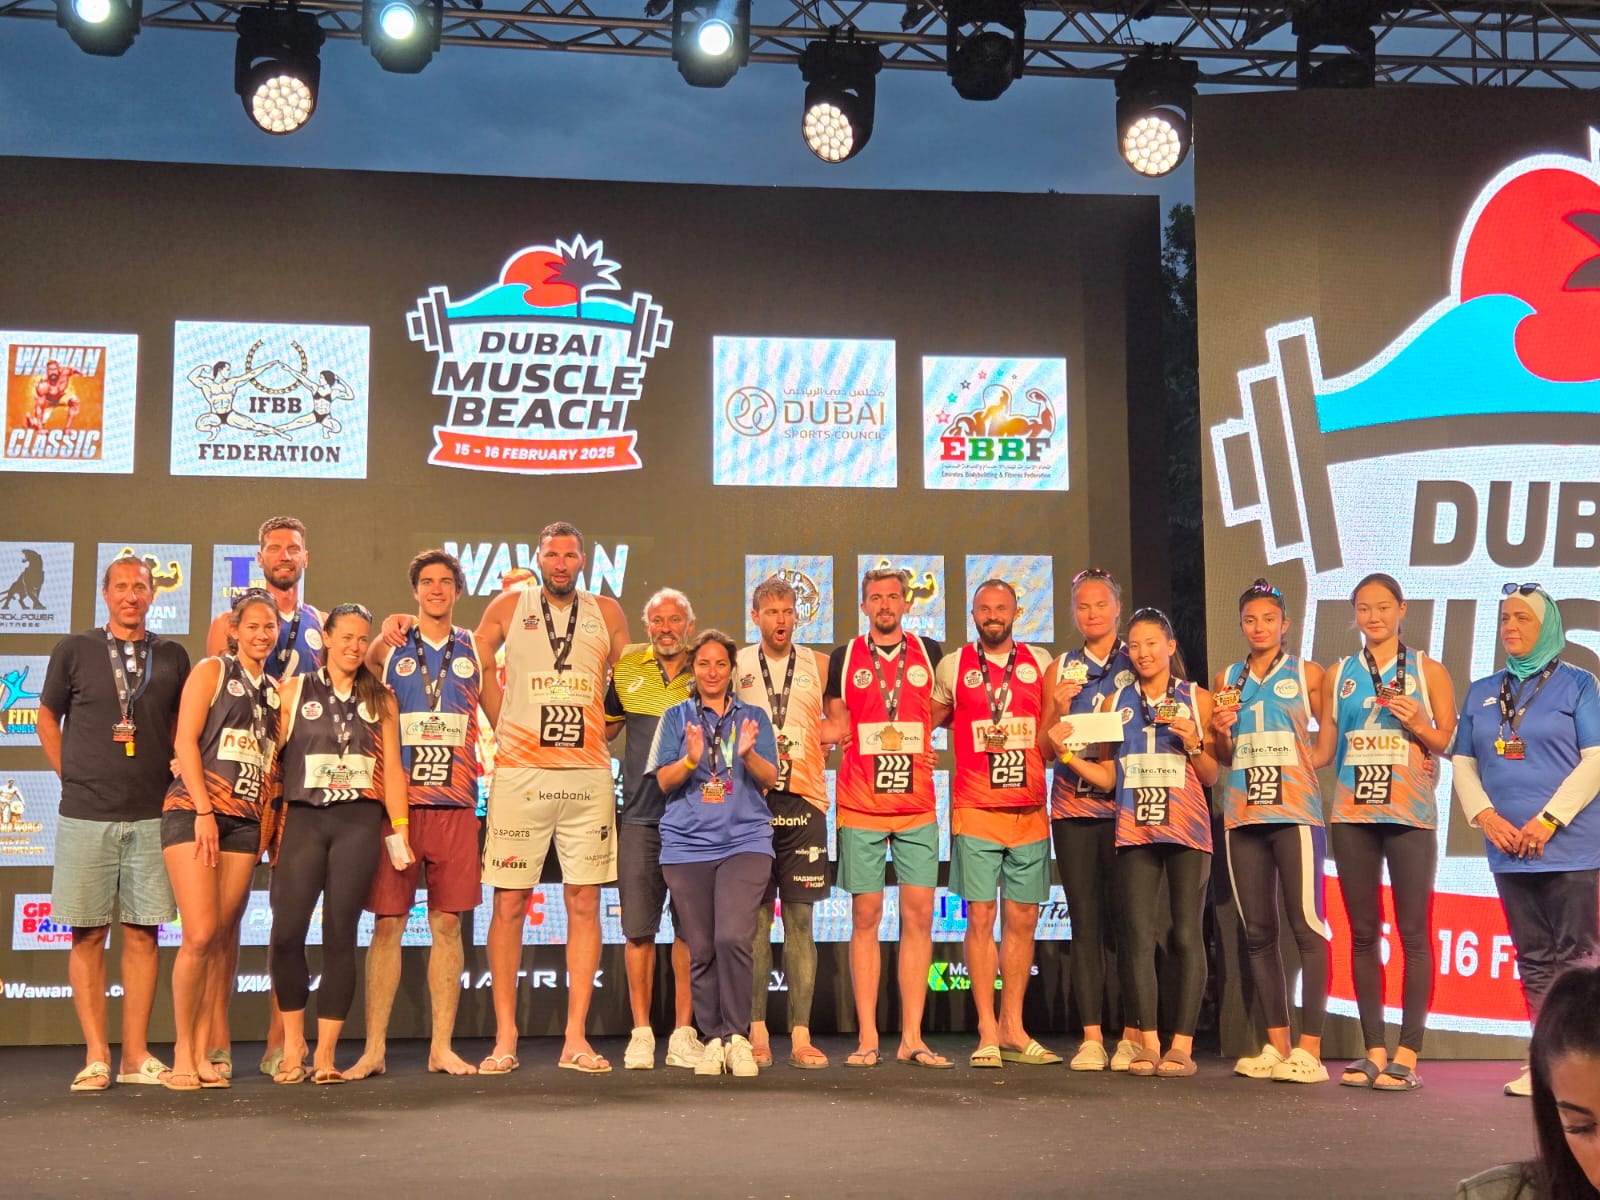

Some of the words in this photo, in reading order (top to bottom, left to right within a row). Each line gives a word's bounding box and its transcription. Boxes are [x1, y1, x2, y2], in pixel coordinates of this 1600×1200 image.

[478, 331, 602, 357] DUBAI
[15, 346, 101, 377] WAWAN
[437, 361, 642, 396] MUSCLE
[849, 388, 885, 397] مجلس
[249, 397, 302, 413] IFBB
[450, 397, 625, 430] BEACH
[783, 400, 884, 425] DUBAI
[7, 430, 101, 457] CLASSIC
[784, 430, 831, 439] SPORTS
[834, 431, 884, 439] COUNCIL
[198, 443, 341, 463] FEDERATION
[455, 443, 470, 456] 15
[484, 445, 499, 458] 16
[502, 447, 577, 461] FEBRUARY
[579, 446, 616, 459] 2025
[940, 436, 1051, 461] EBBF
[531, 676, 592, 691] neus.
[1251, 700, 1265, 732] 1
[542, 723, 581, 742] C5
[1142, 726, 1157, 754] 1
[1350, 735, 1407, 751] exus.
[412, 763, 449, 781] C5
[876, 771, 910, 789] C5
[992, 766, 1024, 784] C5
[234, 778, 261, 798] C5
[539, 790, 591, 801] keabank
[1247, 783, 1279, 800] C5
[1356, 781, 1389, 799] C5
[1135, 803, 1166, 821] C5
[1437, 930, 1479, 977] 16
